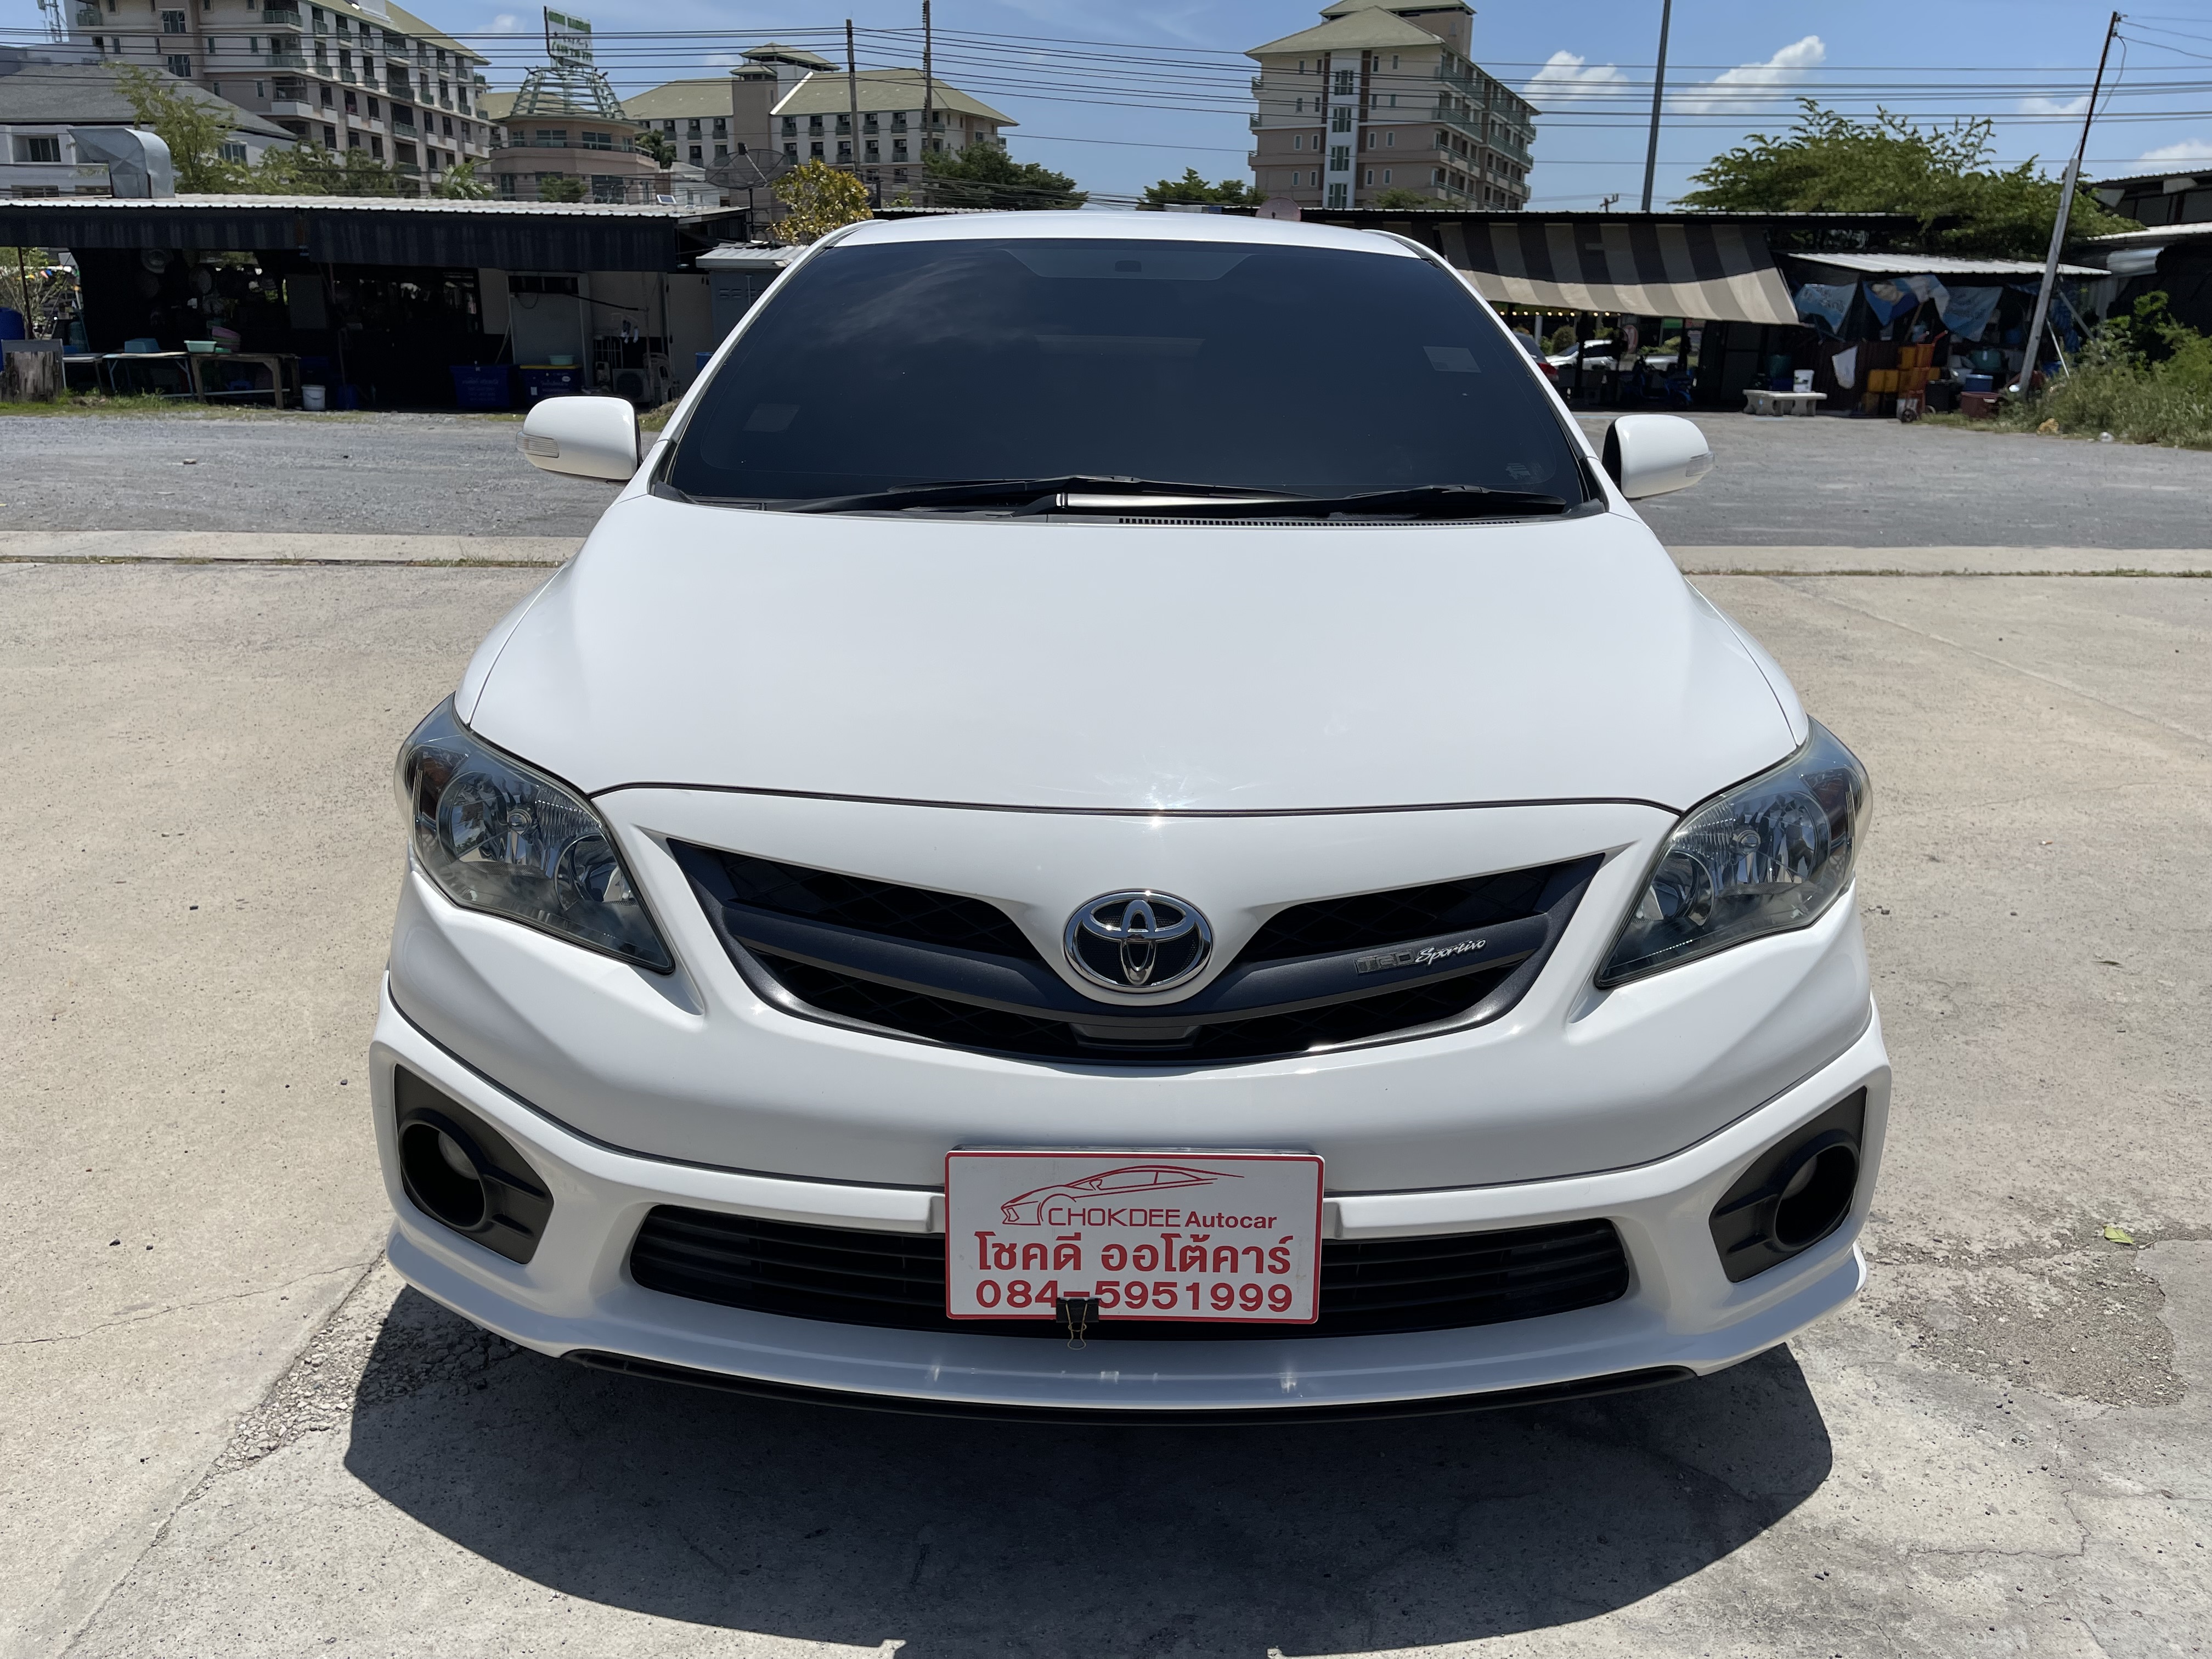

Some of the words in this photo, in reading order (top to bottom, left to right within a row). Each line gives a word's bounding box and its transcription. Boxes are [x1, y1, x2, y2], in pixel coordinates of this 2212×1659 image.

[1356, 950, 1415, 972] TRD
[1415, 939, 1486, 965] Sportivo
[1048, 1208, 1181, 1227] CHOKDEE
[1185, 1211, 1277, 1229] Autocar
[975, 1231, 1081, 1271] โชคดี
[1101, 1233, 1294, 1274] ออโต้คาร์
[976, 1280, 1293, 1312] 084-5951999
